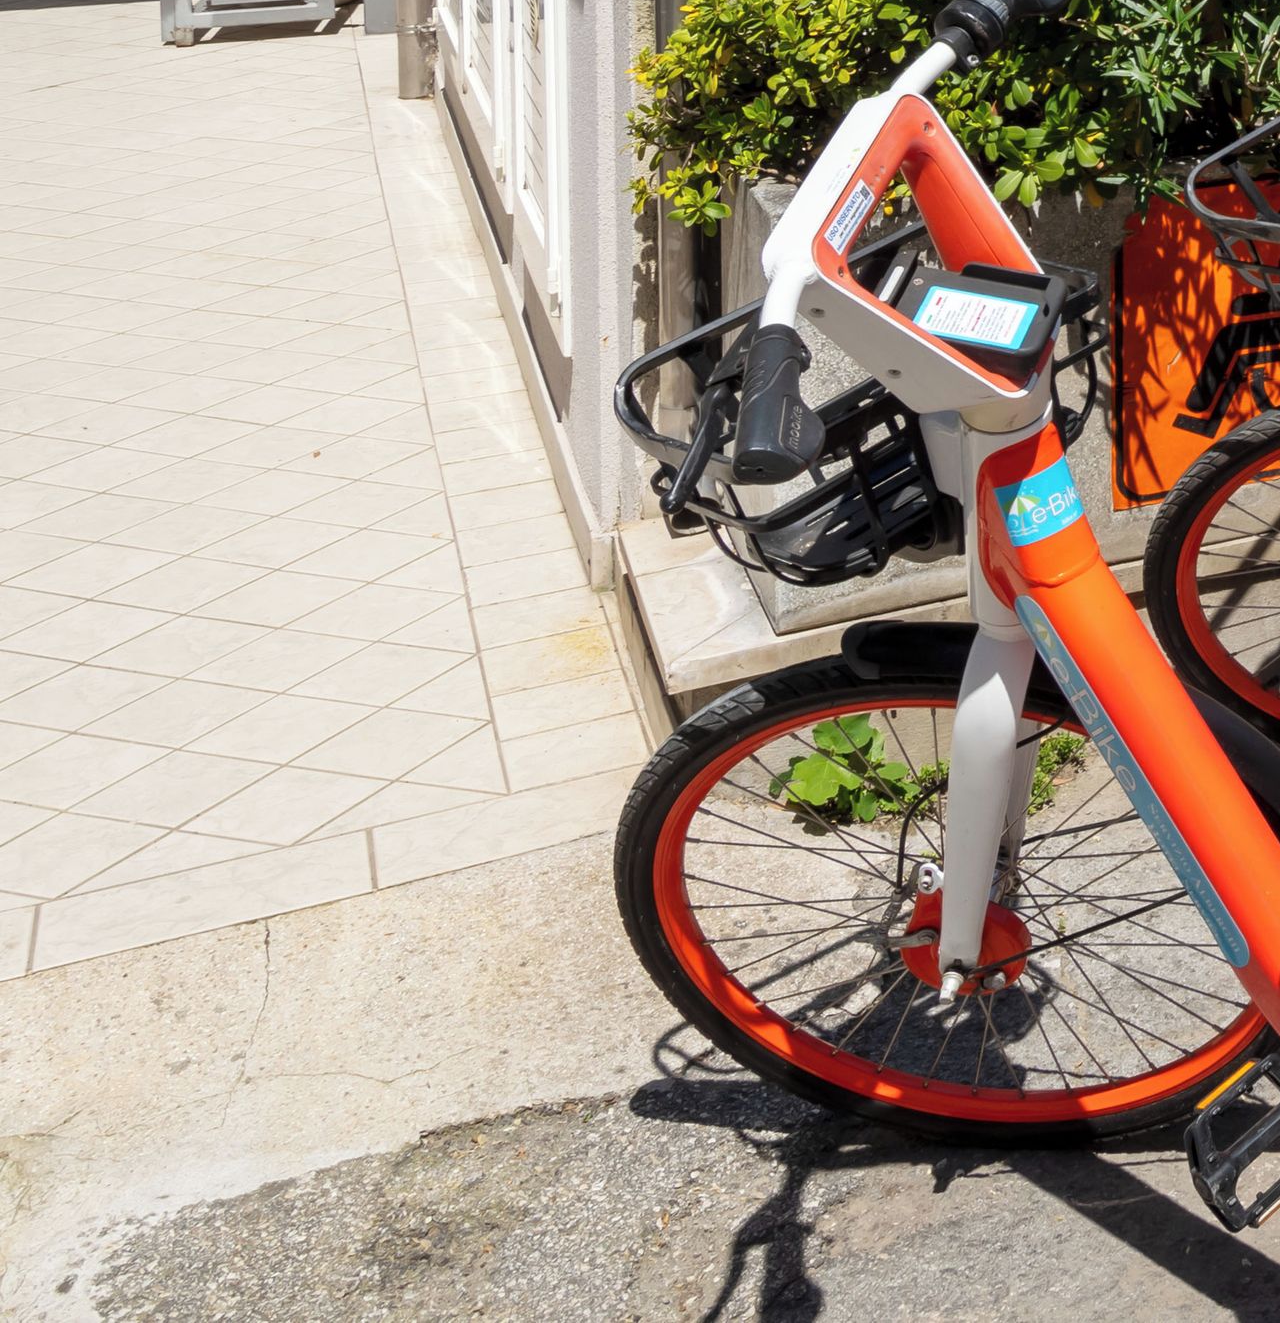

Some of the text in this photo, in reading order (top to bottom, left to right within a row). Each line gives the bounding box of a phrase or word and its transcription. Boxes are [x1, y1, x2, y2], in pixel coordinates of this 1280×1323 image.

[827, 225, 839, 242] USO
[836, 191, 861, 228] RISERVATO
[1032, 485, 1077, 523] e-Bik
[1049, 656, 1136, 794] e-Bike
